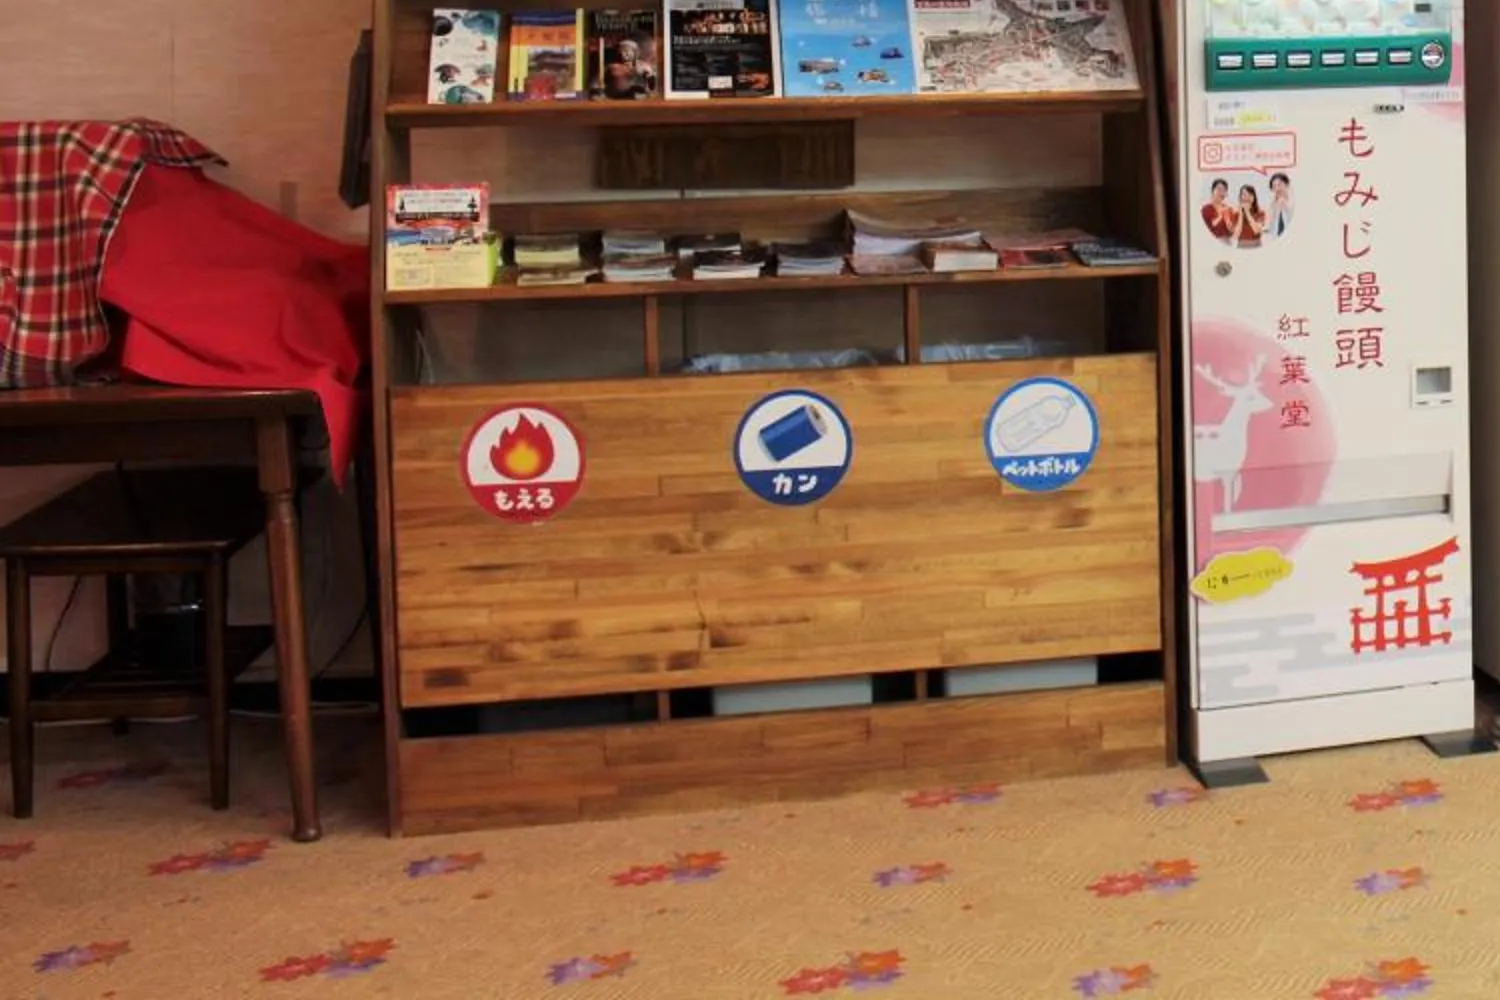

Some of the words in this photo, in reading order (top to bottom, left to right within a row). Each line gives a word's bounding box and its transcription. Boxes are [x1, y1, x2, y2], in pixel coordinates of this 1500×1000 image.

[1332, 116, 1385, 370] もみじ饅頭
[1277, 313, 1311, 429] 紅葉堂
[1002, 456, 1081, 476] ペットボトル
[773, 472, 818, 494] カン
[494, 488, 556, 511] もえる
